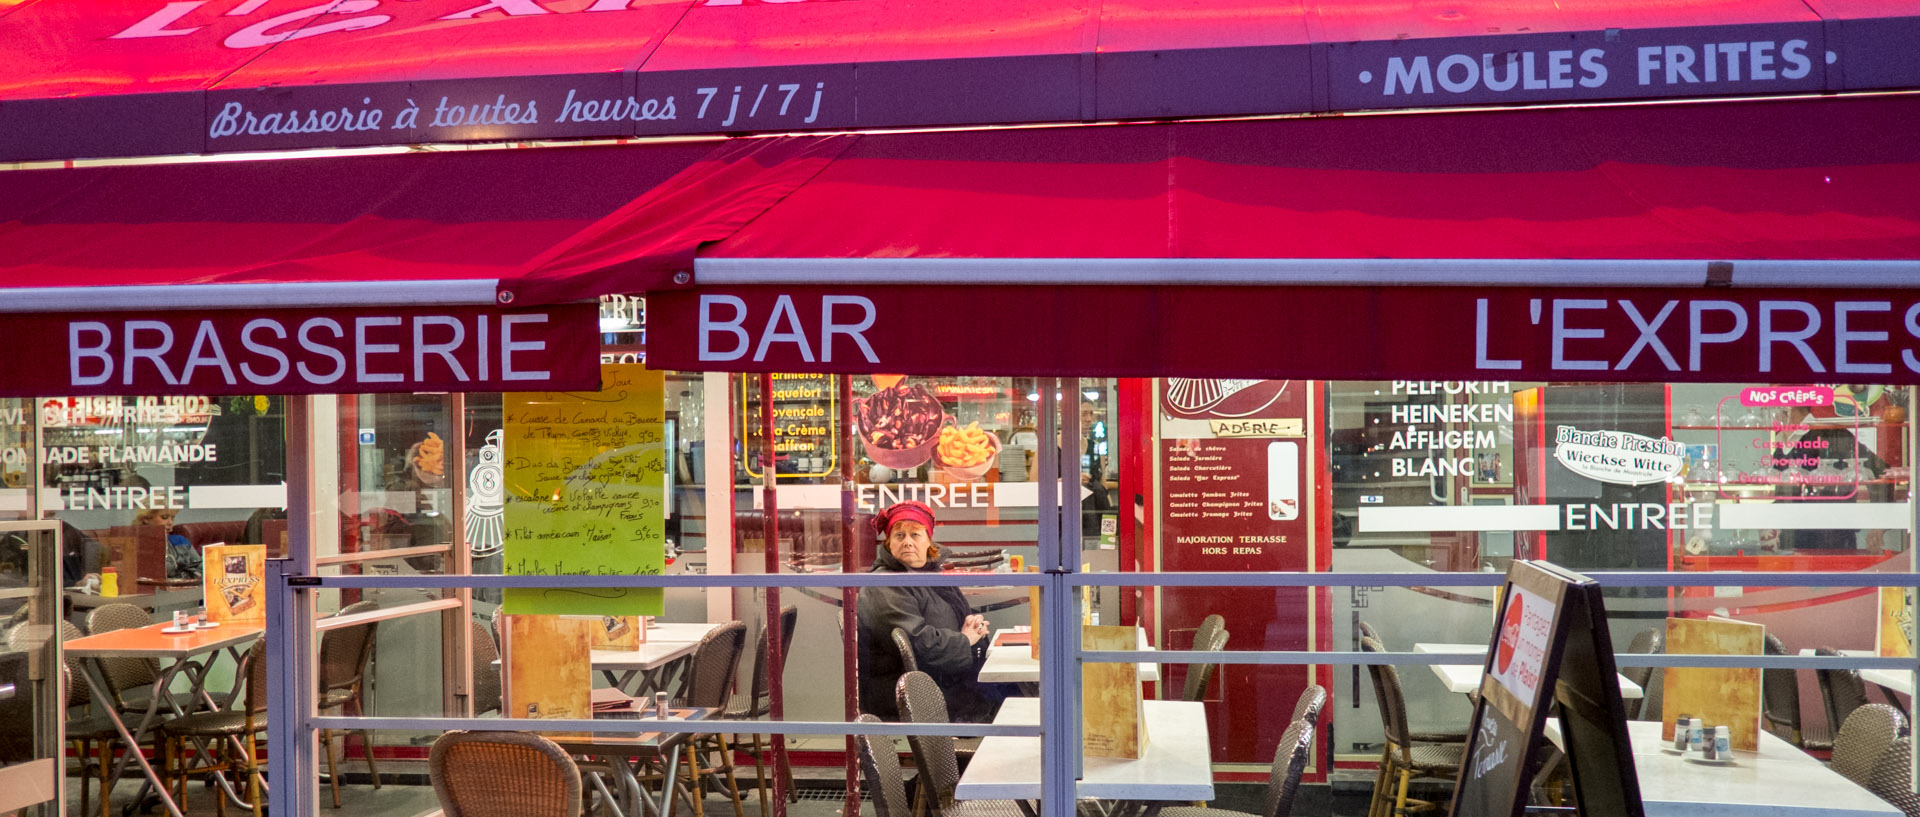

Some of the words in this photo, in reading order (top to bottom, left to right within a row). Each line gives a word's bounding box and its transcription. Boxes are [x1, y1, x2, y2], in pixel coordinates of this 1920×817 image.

[1383, 48, 1608, 95] MOULES
[1638, 40, 1811, 85] FRITES
[210, 96, 383, 139] Brasserie
[391, 95, 417, 129] à
[430, 95, 538, 127] toutes
[556, 89, 677, 122] heures
[699, 295, 881, 364] BAR
[68, 313, 551, 386] BRASSERIE
[772, 386, 822, 401] oquefort
[1392, 381, 1510, 395] PELFORTH
[1750, 390, 1777, 402] NOS
[1779, 390, 1824, 404] CRÊPES
[554, 409, 567, 424] de
[572, 410, 608, 424] Canard
[759, 404, 824, 419] ovençale
[1391, 404, 1513, 424] HEINEKEN
[523, 428, 535, 439] de
[788, 424, 827, 436] Crème
[1772, 421, 1809, 432] Sucre
[774, 439, 815, 451] affran
[1389, 430, 1496, 450] AFFLIGEM
[1557, 426, 1617, 448] Blanche
[1622, 434, 1685, 456] Pression
[1752, 437, 1829, 449] Cassonade
[99, 444, 217, 464] FLAMANDE
[1566, 450, 1627, 467] Wieckse
[1633, 458, 1672, 472] Witte
[1761, 455, 1821, 466] Chocolat
[1391, 458, 1474, 477] BLANC
[69, 486, 184, 510] ENTREE
[857, 482, 989, 509] ENTREE
[1565, 503, 1713, 530] ENTREE
[1176, 536, 1233, 544] MAJORATION
[1239, 535, 1287, 543] TERRASSE
[1202, 547, 1227, 555] HORS
[1233, 547, 1262, 555] REPAS
